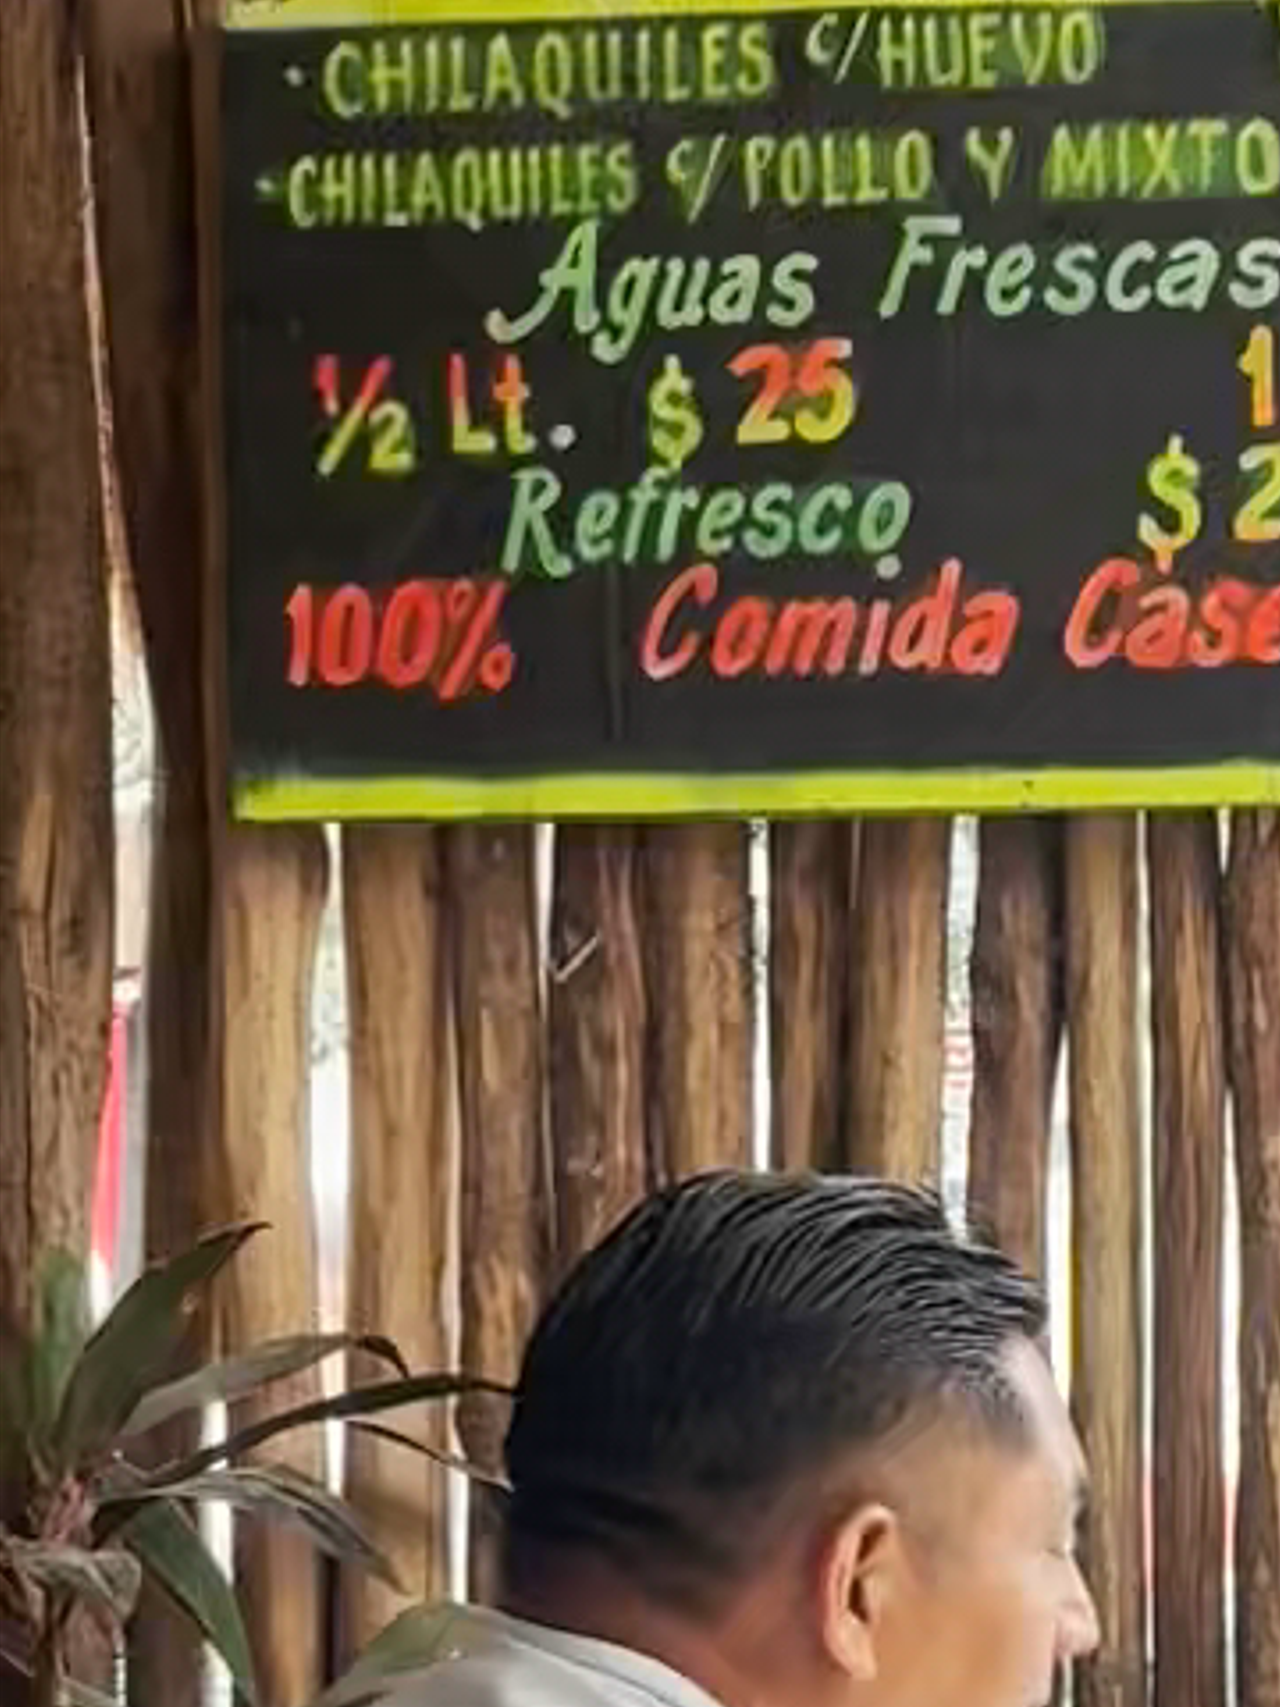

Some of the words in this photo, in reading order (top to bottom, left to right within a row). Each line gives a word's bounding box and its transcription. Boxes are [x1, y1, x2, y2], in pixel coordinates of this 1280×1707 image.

[323, 22, 775, 119] CHILAQUILES
[288, 140, 637, 232] CHILAQUILES
[964, 124, 1015, 203] Y
[485, 218, 818, 363] Aguas
[447, 352, 576, 455] Lt.
[502, 465, 912, 579] Refresco
[285, 578, 516, 701] 100%
[641, 557, 1021, 681] Comida
